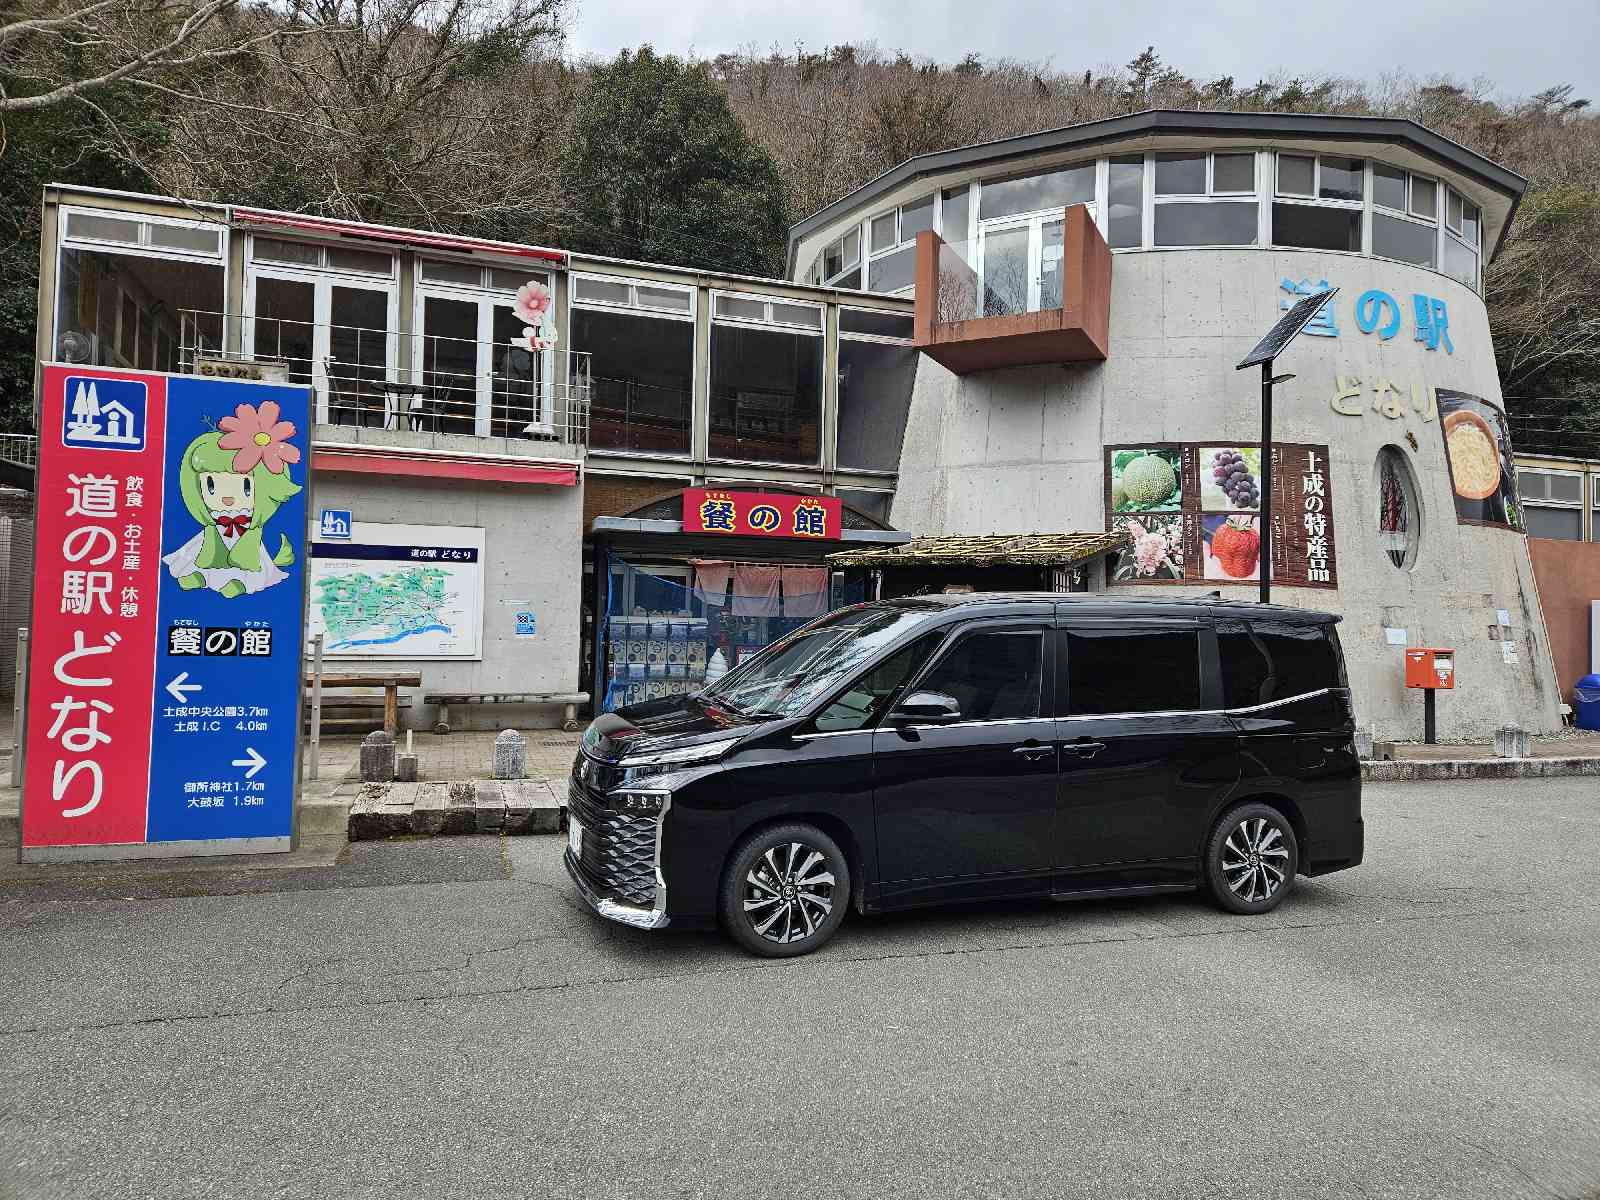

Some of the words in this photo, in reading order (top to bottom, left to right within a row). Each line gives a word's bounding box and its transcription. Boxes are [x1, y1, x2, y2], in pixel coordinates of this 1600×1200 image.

[1330, 374, 1437, 424] どなり
[699, 499, 827, 537] 餐の館
[1301, 450, 1330, 582] 土成の特産品
[119, 475, 144, 618] 飲食・お土産・休憩
[411, 549, 437, 558] 道の駅
[441, 550, 471, 560] どなり
[169, 627, 271, 655] 餐の館
[235, 720, 268, 732] 4.0km
[233, 795, 265, 807] 1.9km
